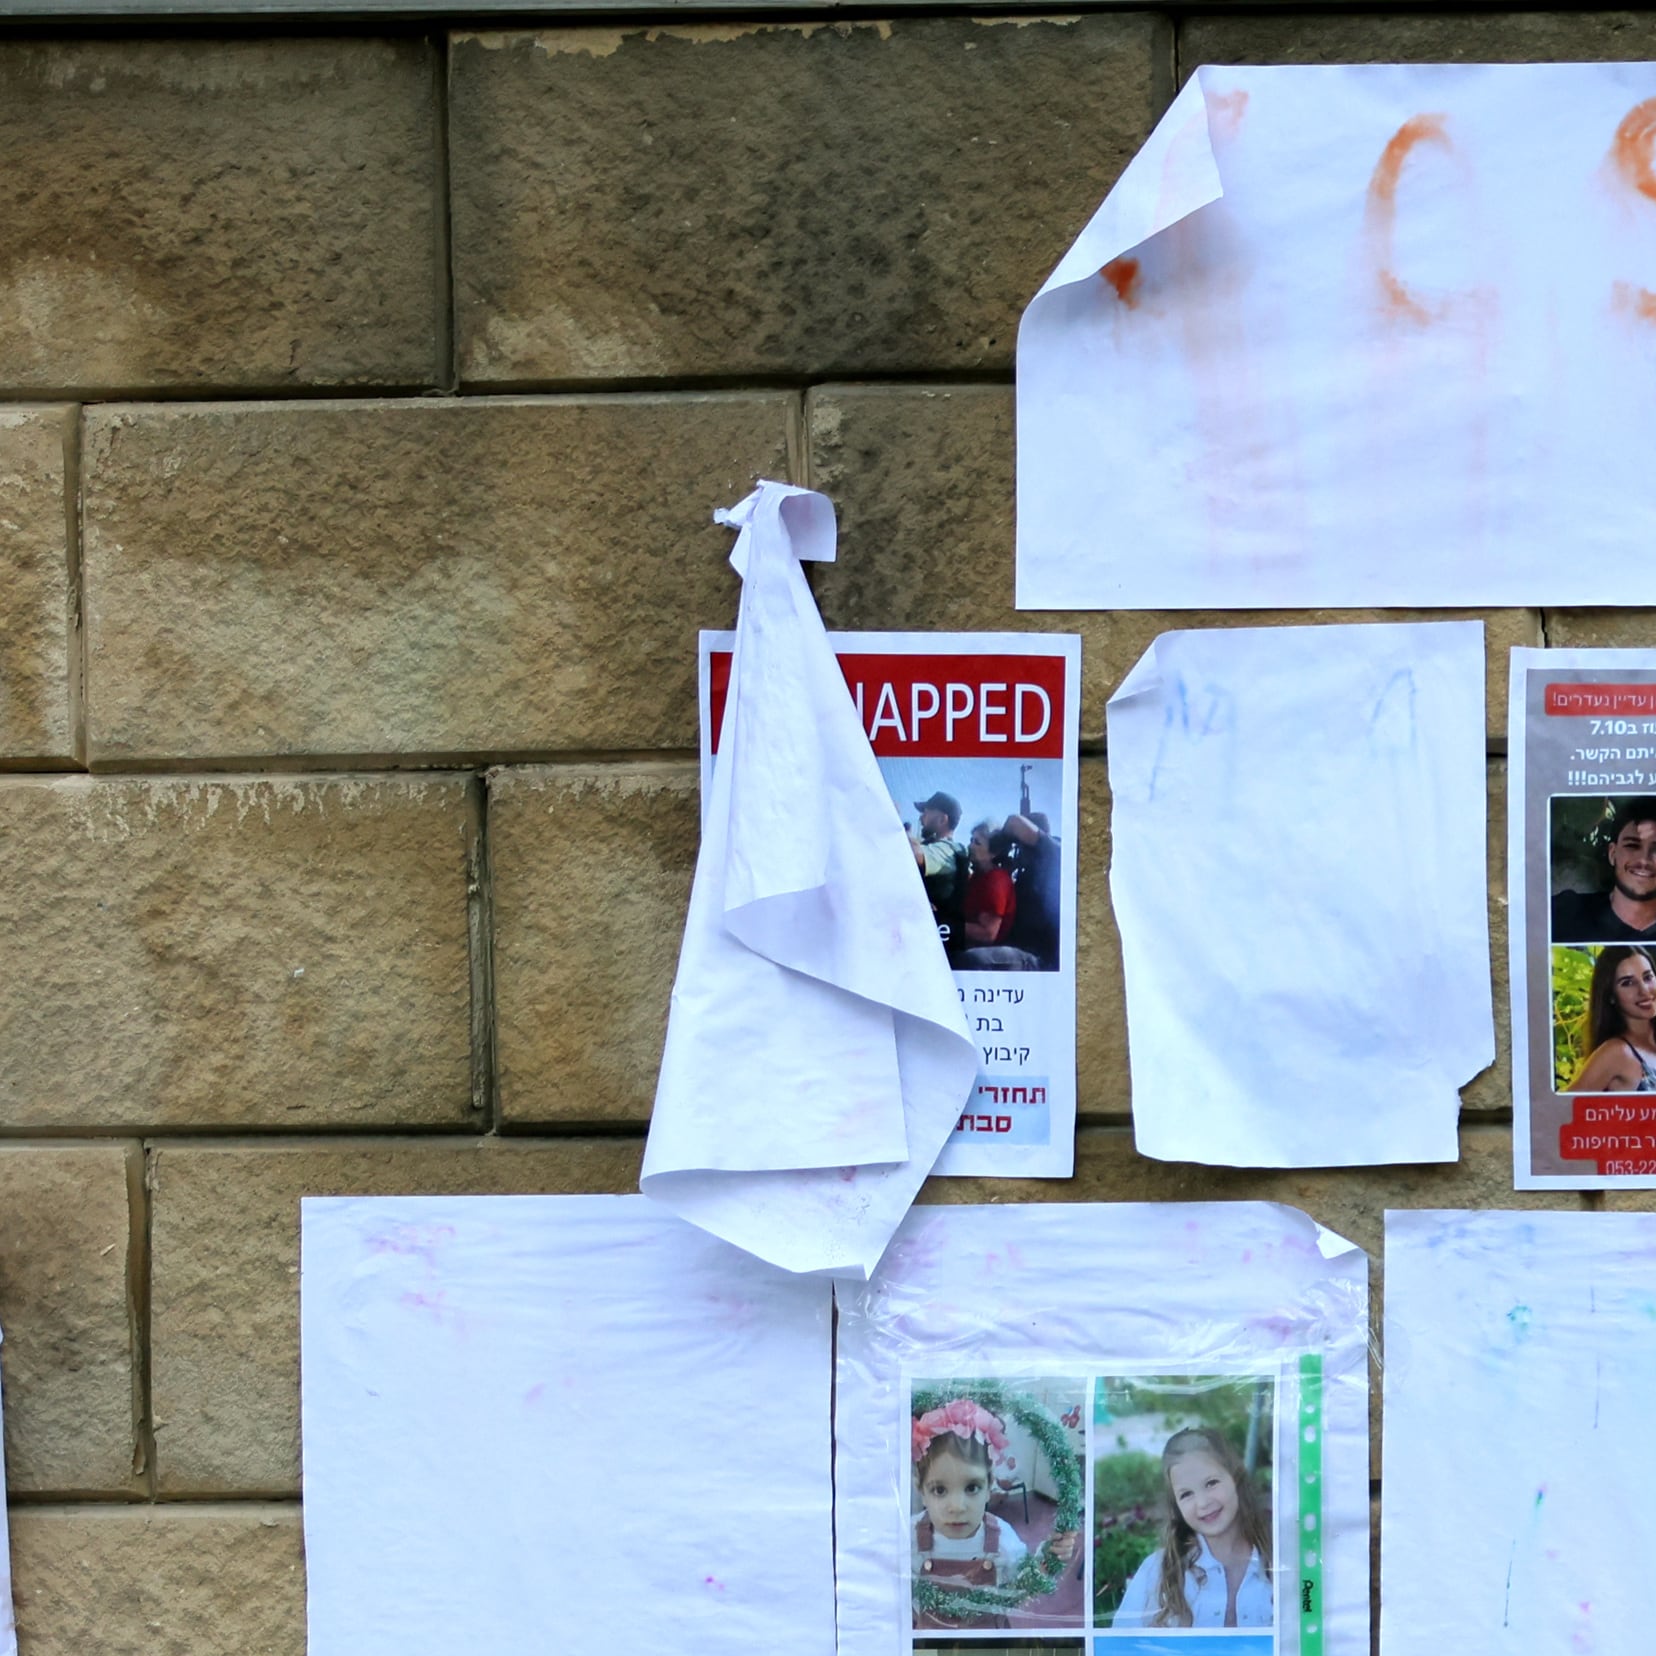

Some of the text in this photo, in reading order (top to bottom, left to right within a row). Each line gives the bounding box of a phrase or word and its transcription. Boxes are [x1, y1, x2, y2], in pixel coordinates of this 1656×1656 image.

[1570, 748, 1621, 763] הקשר.
[1568, 769, 1644, 786] לגביהם!!!
[974, 988, 1024, 1004] עדינה
[976, 1017, 1004, 1032] בת
[983, 1047, 1030, 1066] קיבוץ
[978, 1086, 1045, 1104] תחזרי
[1585, 1104, 1635, 1122] עליהם
[954, 1113, 1011, 1132] סבת
[1572, 1136, 1642, 1149] בדחיפות
